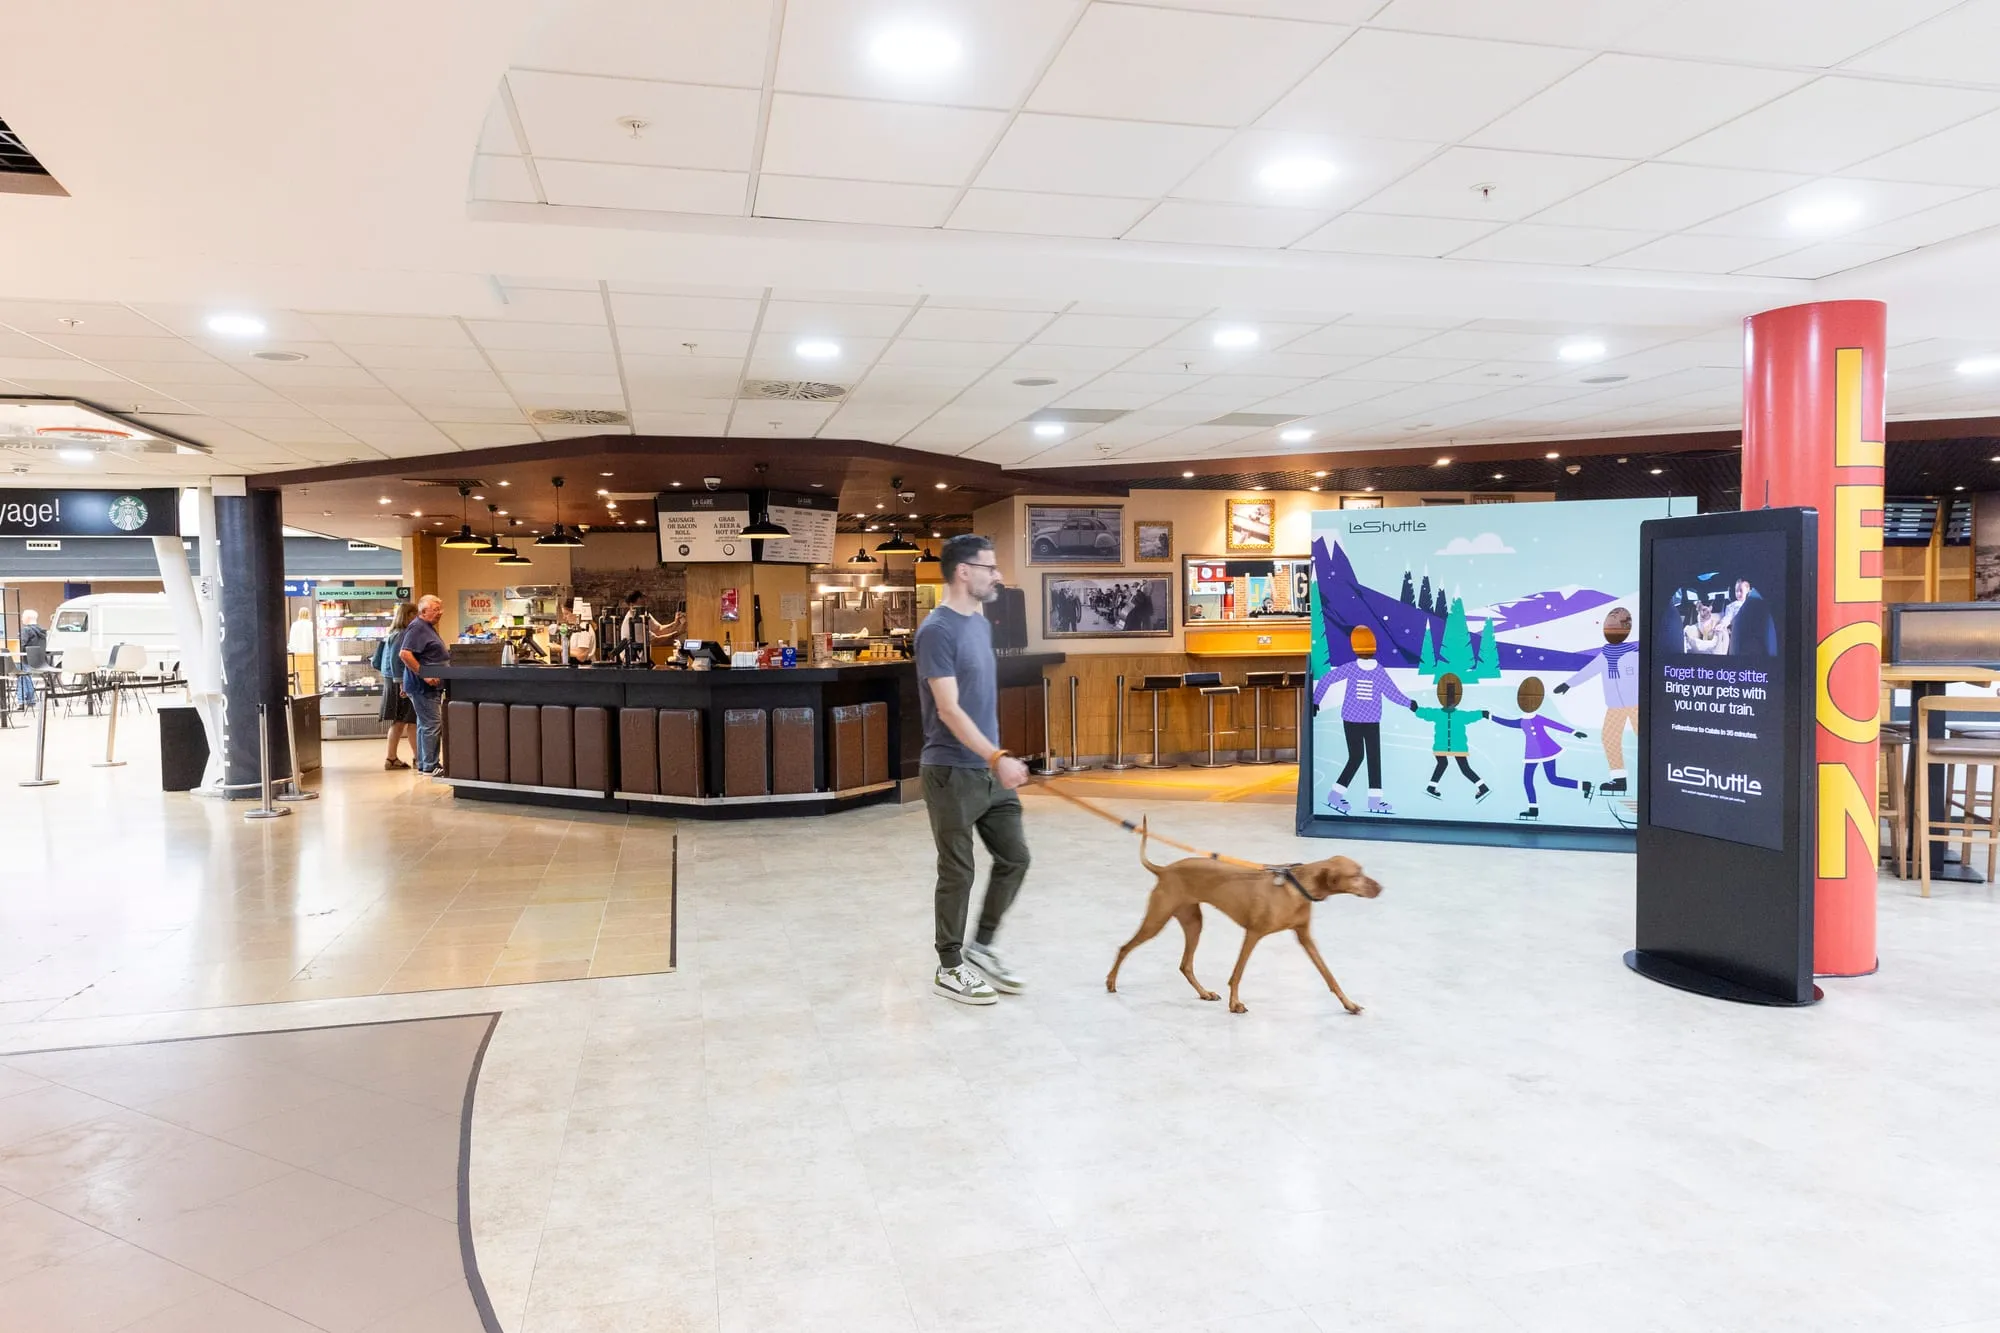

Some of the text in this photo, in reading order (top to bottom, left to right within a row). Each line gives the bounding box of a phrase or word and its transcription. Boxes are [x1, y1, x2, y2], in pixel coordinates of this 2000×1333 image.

[1349, 520, 1427, 533] LeShuttle
[470, 599, 491, 608] KIDS
[1664, 665, 1769, 683] Forget the dog sitter.
[1665, 681, 1766, 700] Bring your pets with
[1674, 699, 1756, 716] you on our train.
[1667, 763, 1762, 796] LeShuttle
